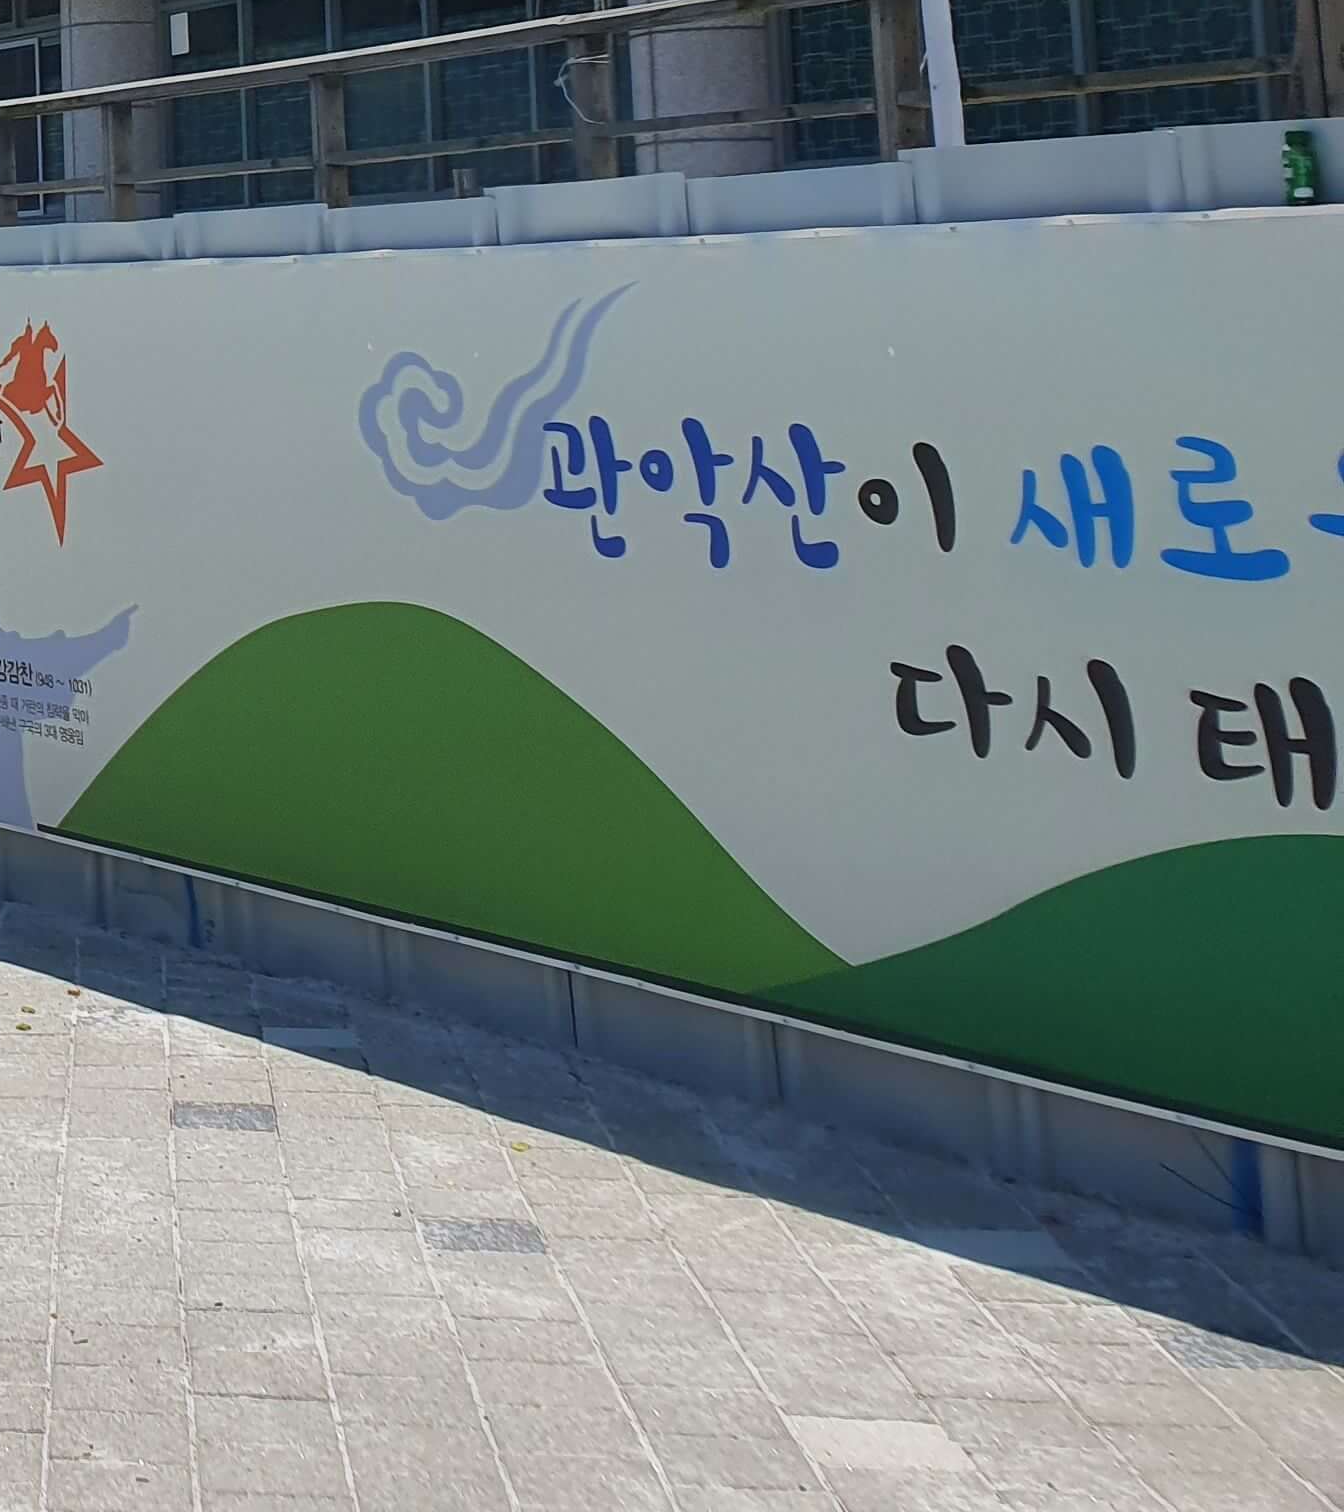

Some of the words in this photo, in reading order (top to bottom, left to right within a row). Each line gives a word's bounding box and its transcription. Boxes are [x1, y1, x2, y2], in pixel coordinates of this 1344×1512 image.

[542, 414, 957, 569] 관악산이
[1010, 435, 1344, 582] 새로
[889, 643, 1137, 781] 다시
